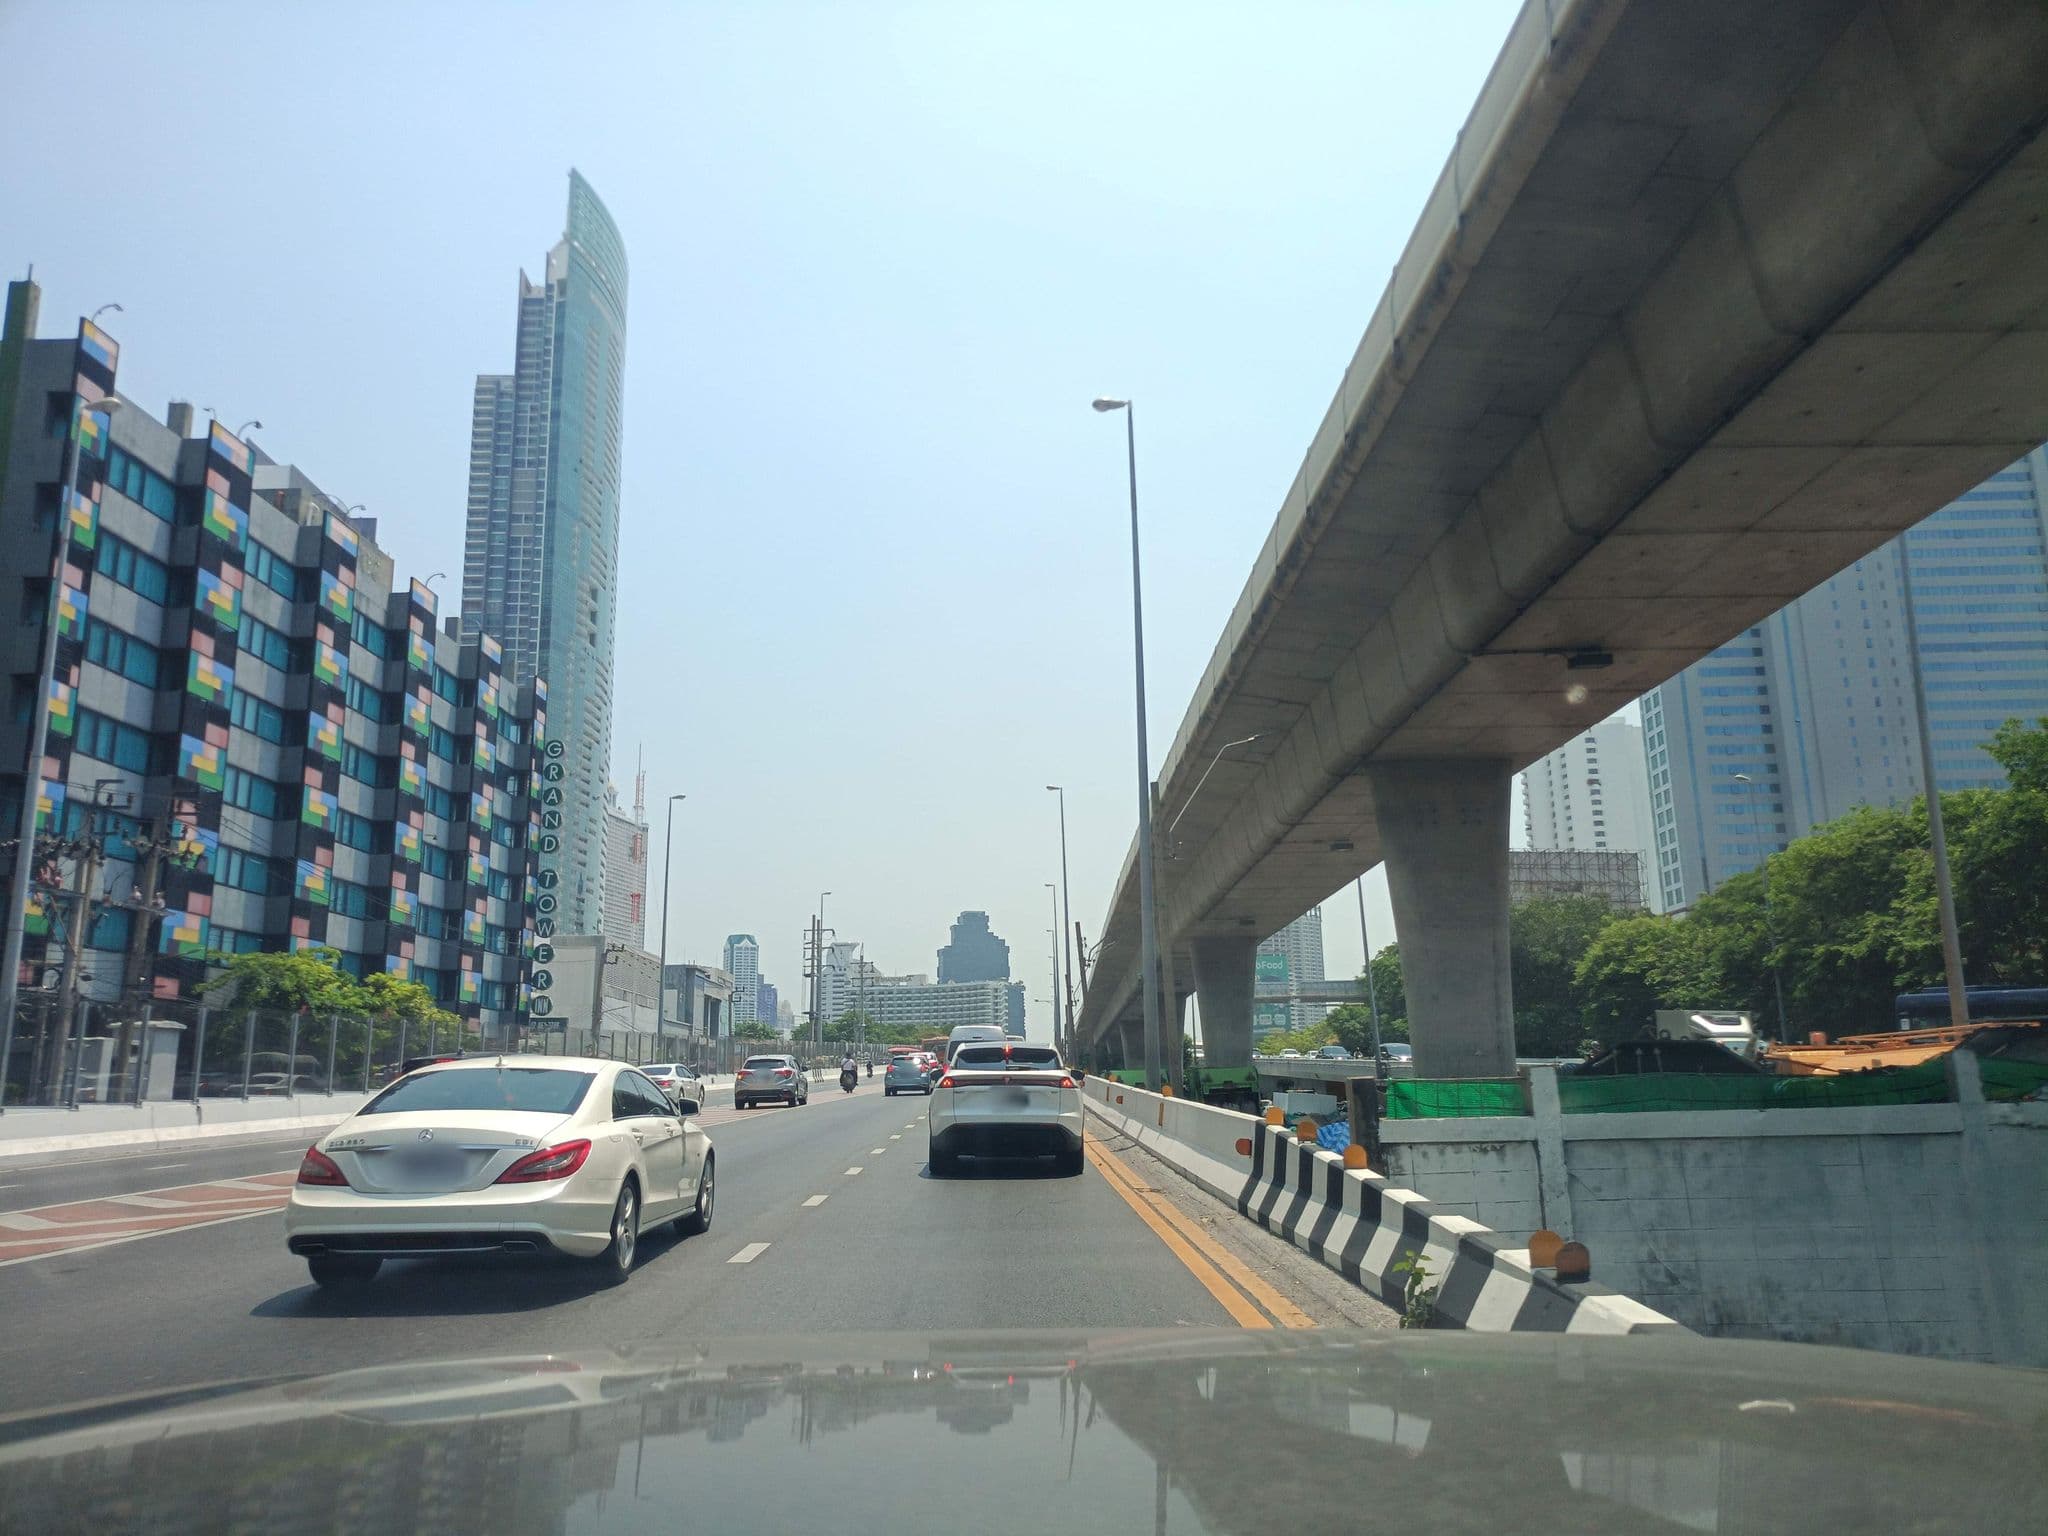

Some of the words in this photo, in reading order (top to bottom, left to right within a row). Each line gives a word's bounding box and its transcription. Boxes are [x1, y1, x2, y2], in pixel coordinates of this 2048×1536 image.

[544, 741, 562, 852] GRAND
[537, 871, 553, 988] TOWER
[534, 997, 549, 1014] INN
